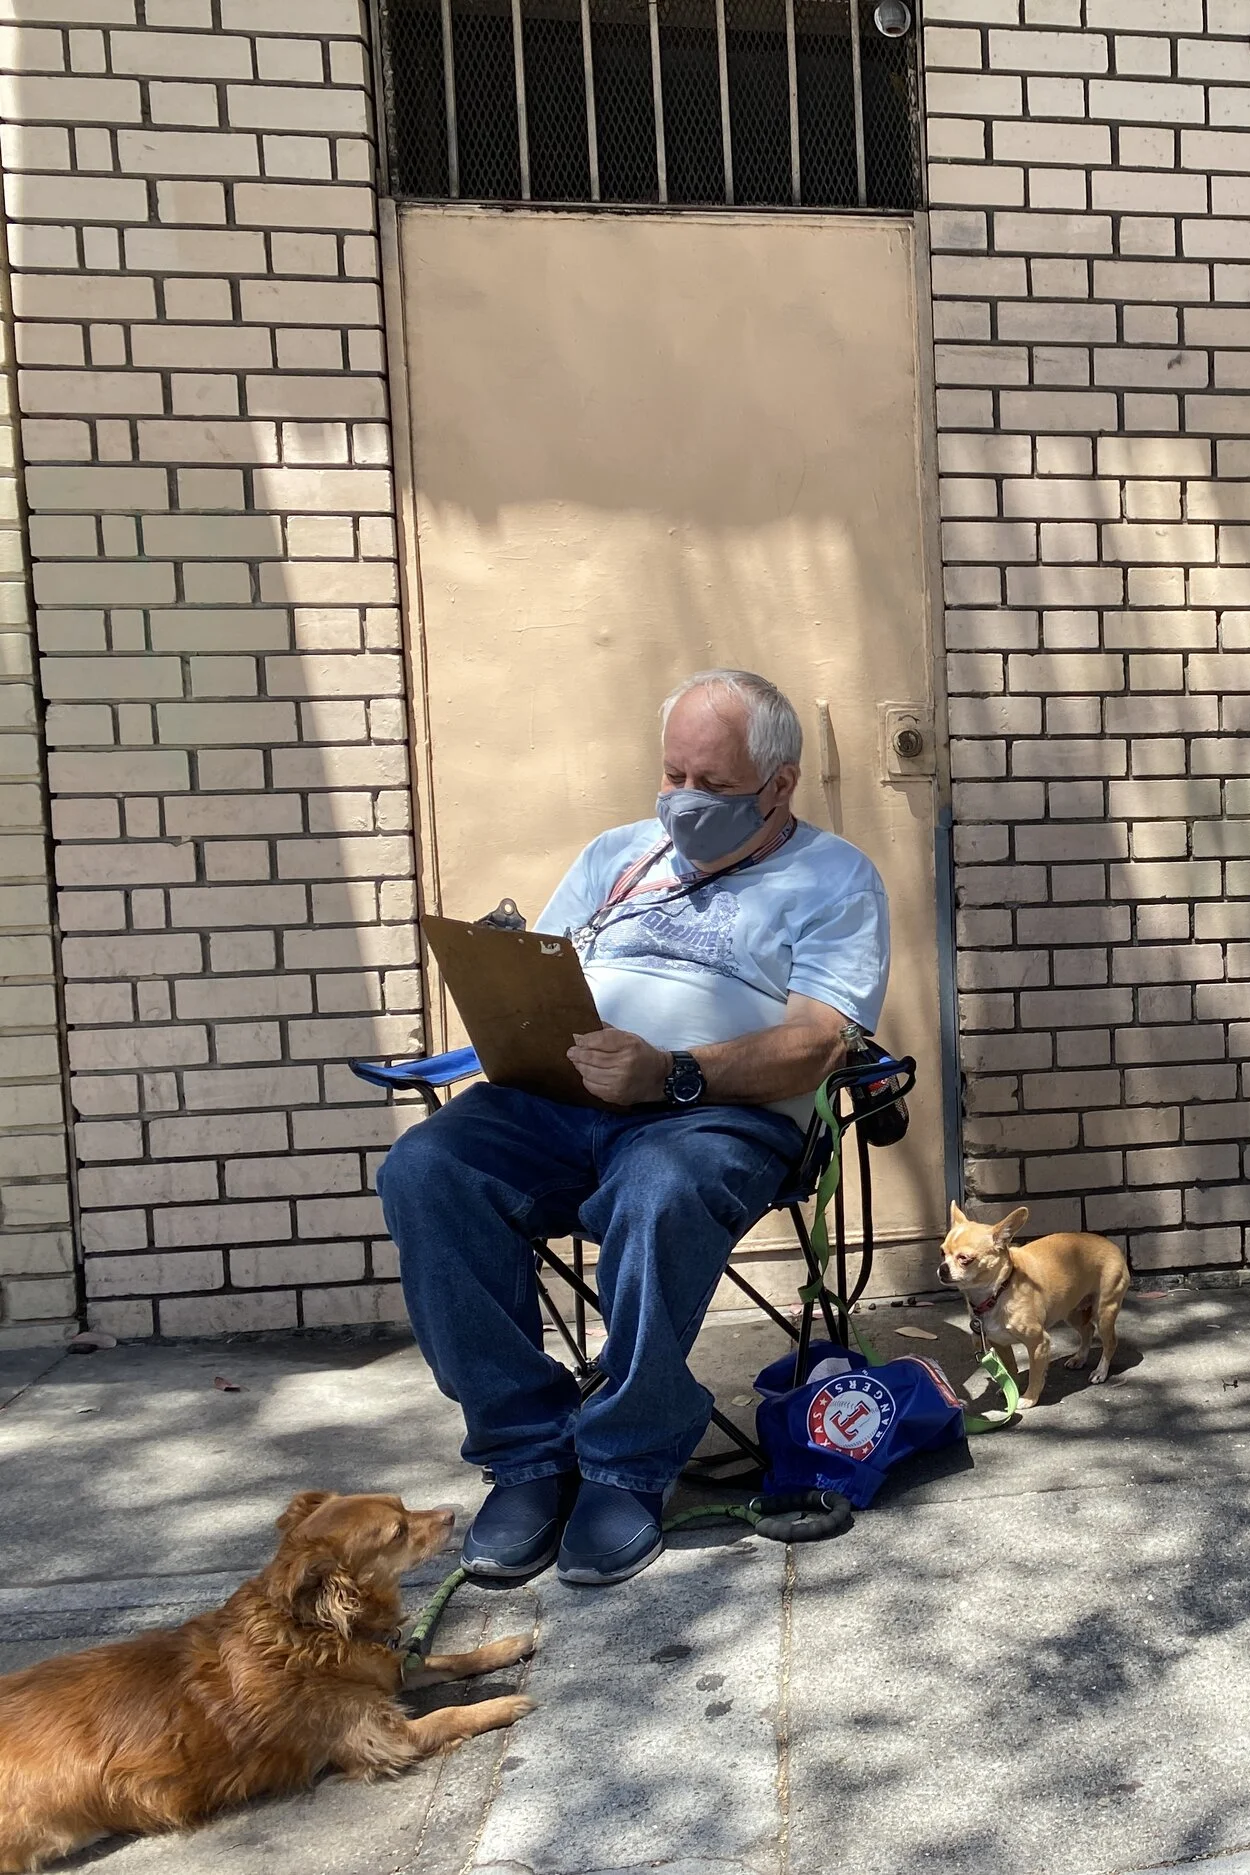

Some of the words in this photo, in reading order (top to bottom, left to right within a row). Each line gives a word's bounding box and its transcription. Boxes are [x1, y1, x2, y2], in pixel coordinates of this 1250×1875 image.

[829, 1399, 871, 1442] T
[834, 1380, 891, 1438] RANGERS
[812, 1411, 855, 1457] XAS
